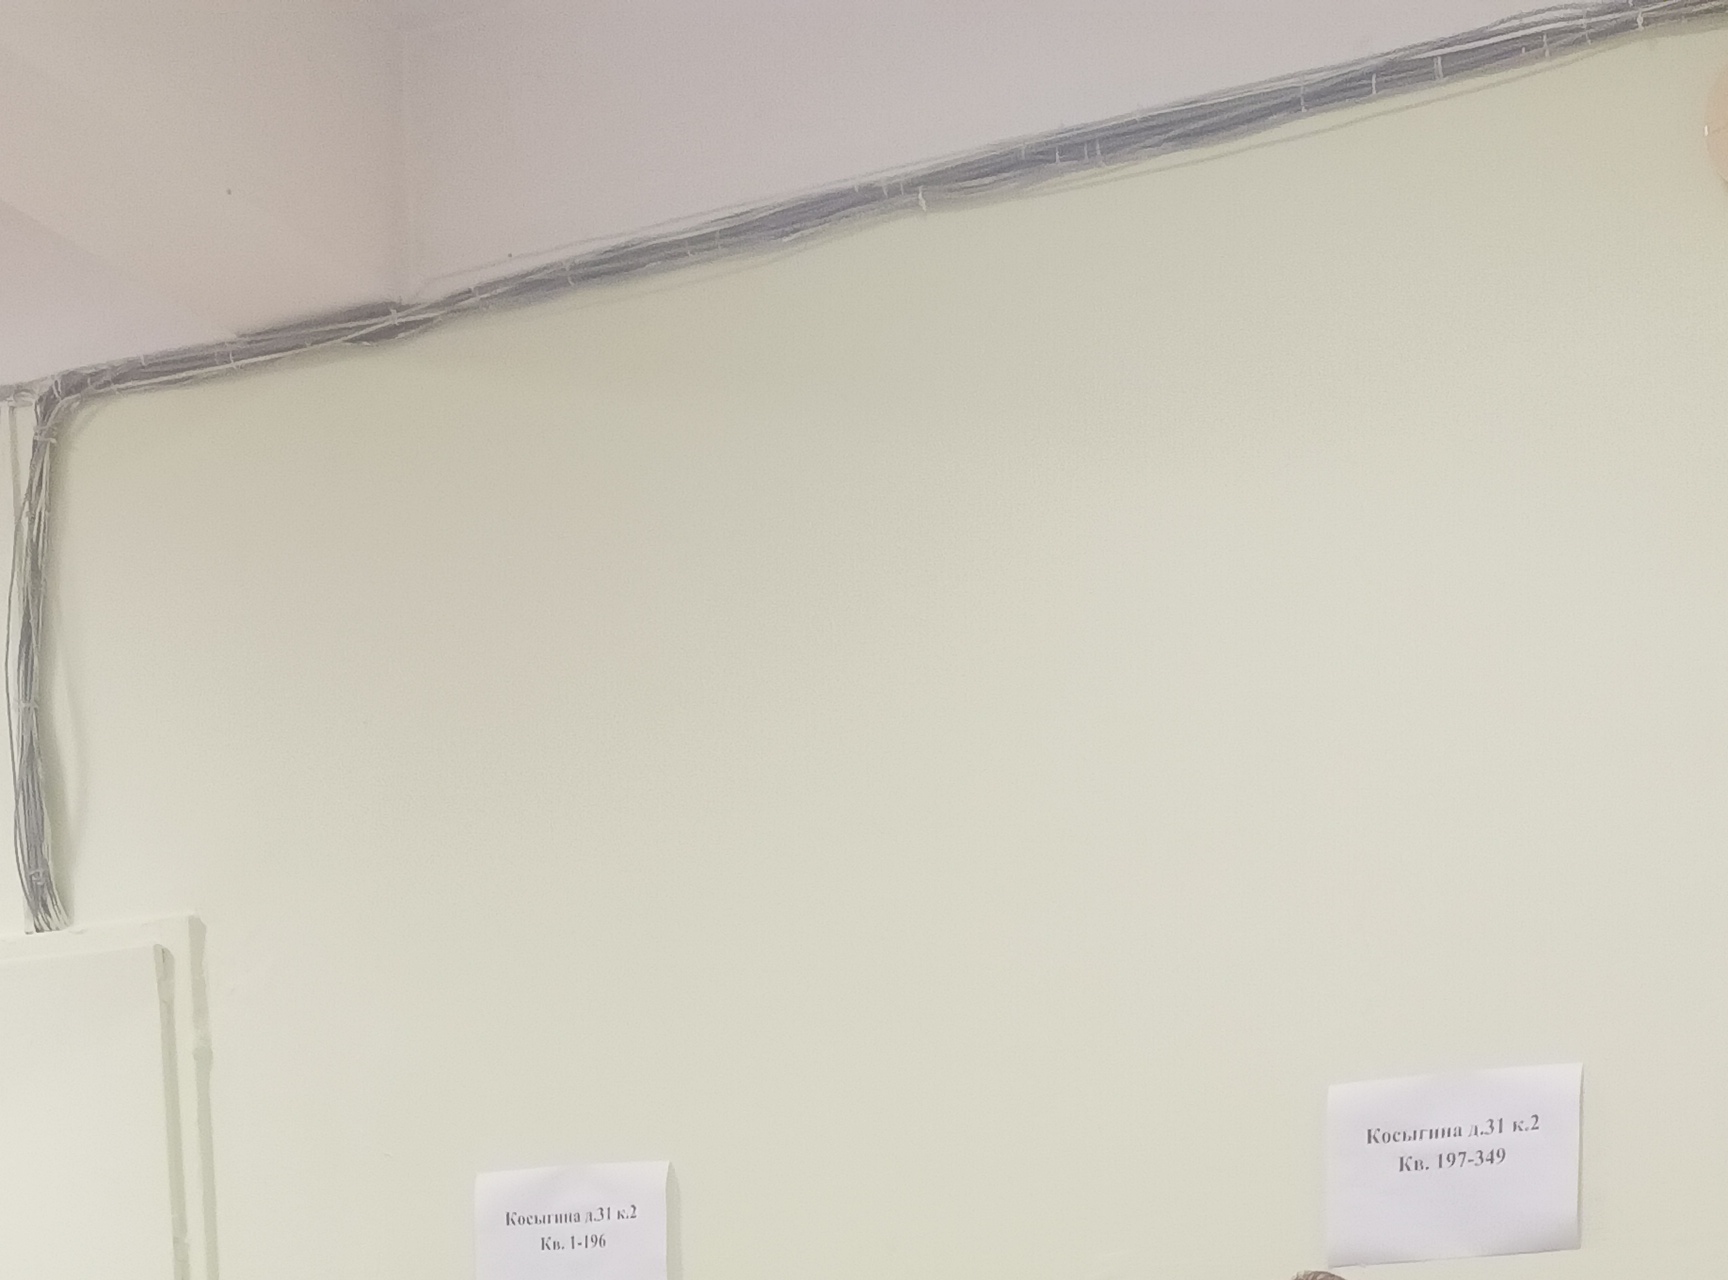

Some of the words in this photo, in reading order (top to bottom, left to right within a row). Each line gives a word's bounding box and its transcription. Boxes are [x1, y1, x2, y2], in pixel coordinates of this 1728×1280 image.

[1366, 1126, 1463, 1144] Косыгина
[1468, 1117, 1504, 1138] д.31
[1512, 1113, 1540, 1133] к.2
[1399, 1154, 1430, 1173] Кв.
[1437, 1147, 1507, 1169] 197-349
[505, 1211, 581, 1227] Косыгина
[585, 1206, 611, 1223] д.31
[617, 1204, 638, 1220] к.2
[541, 1236, 565, 1251] Кв.
[570, 1233, 606, 1250] 1-196
